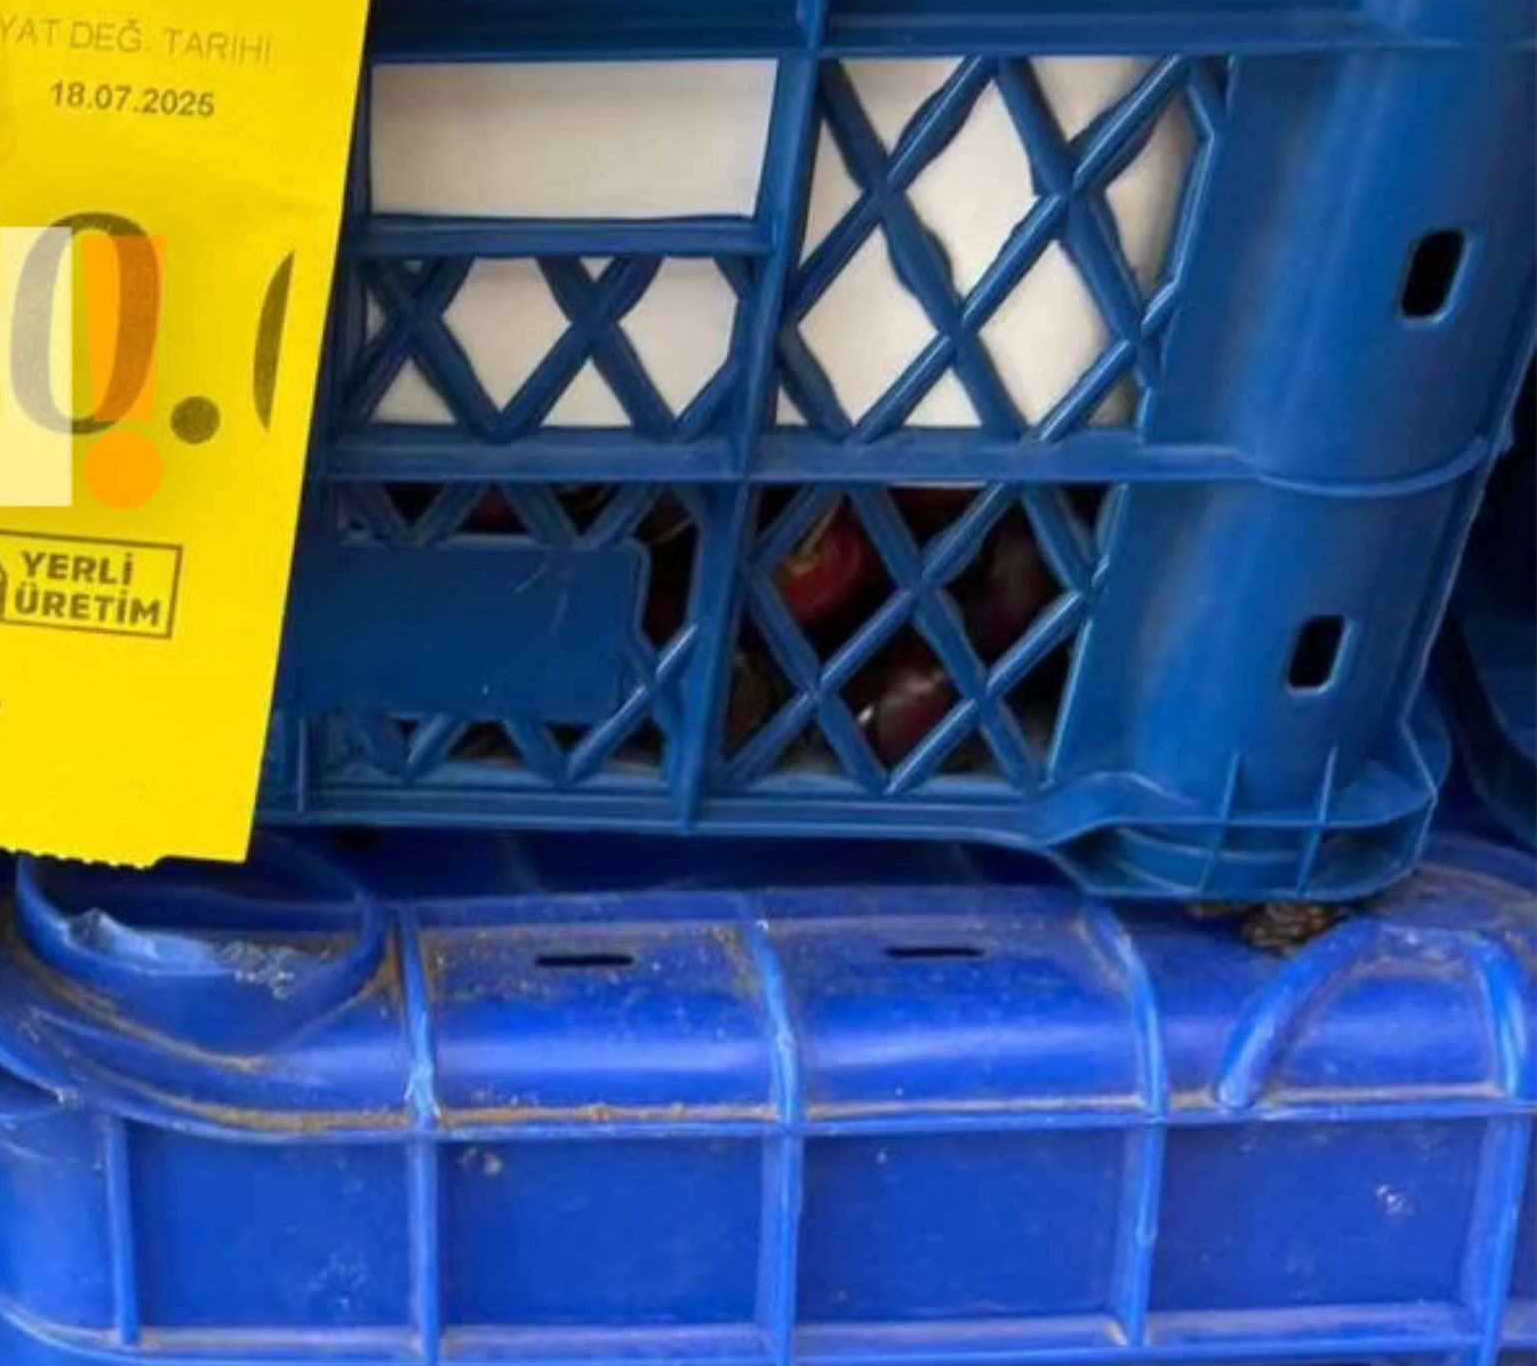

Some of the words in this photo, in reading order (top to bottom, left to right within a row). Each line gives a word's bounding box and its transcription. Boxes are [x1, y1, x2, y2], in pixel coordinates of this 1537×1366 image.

[49, 78, 216, 118] 18.07.2025
[21, 549, 134, 586] YERLİ
[14, 580, 162, 627] ÜRETİM
